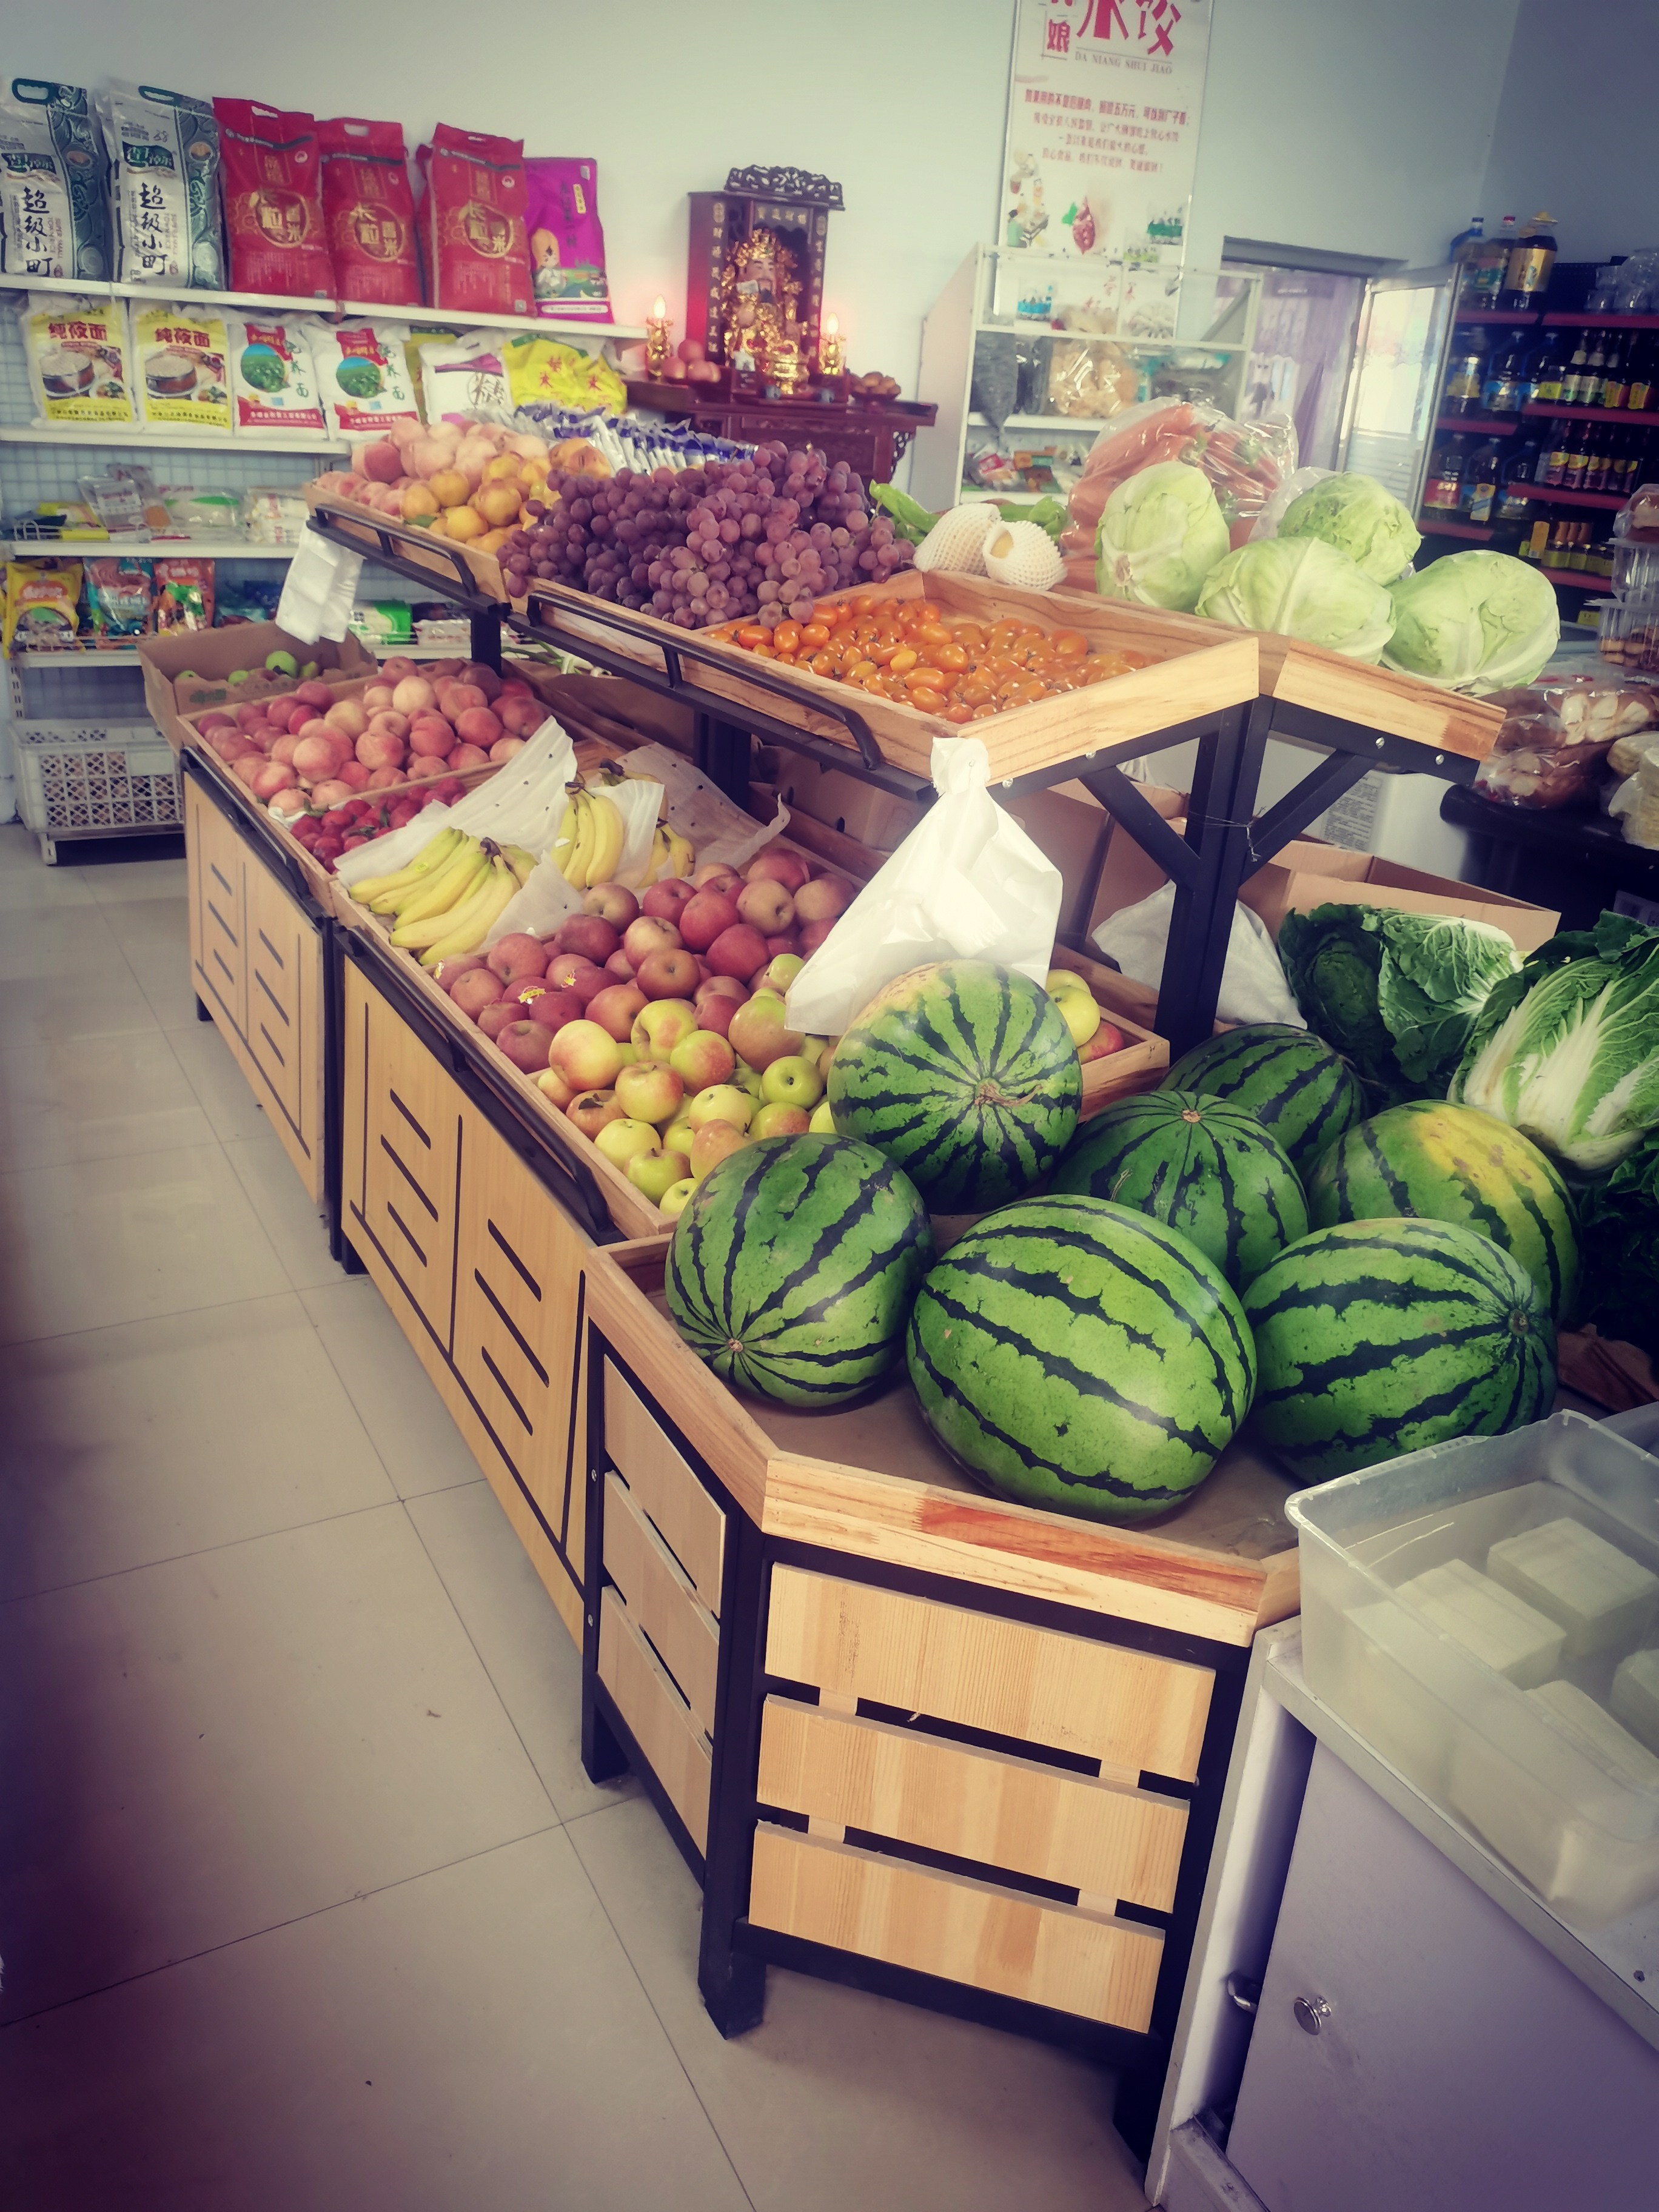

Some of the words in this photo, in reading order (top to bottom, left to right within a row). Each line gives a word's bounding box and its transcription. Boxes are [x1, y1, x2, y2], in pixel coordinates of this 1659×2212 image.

[1074, 51, 1087, 62] DA
[1092, 55, 1121, 67] NIANG
[1125, 59, 1147, 72] SHUI
[1150, 62, 1173, 75] JIAO
[21, 186, 53, 277] 超级小町
[138, 182, 168, 275] 超级小町
